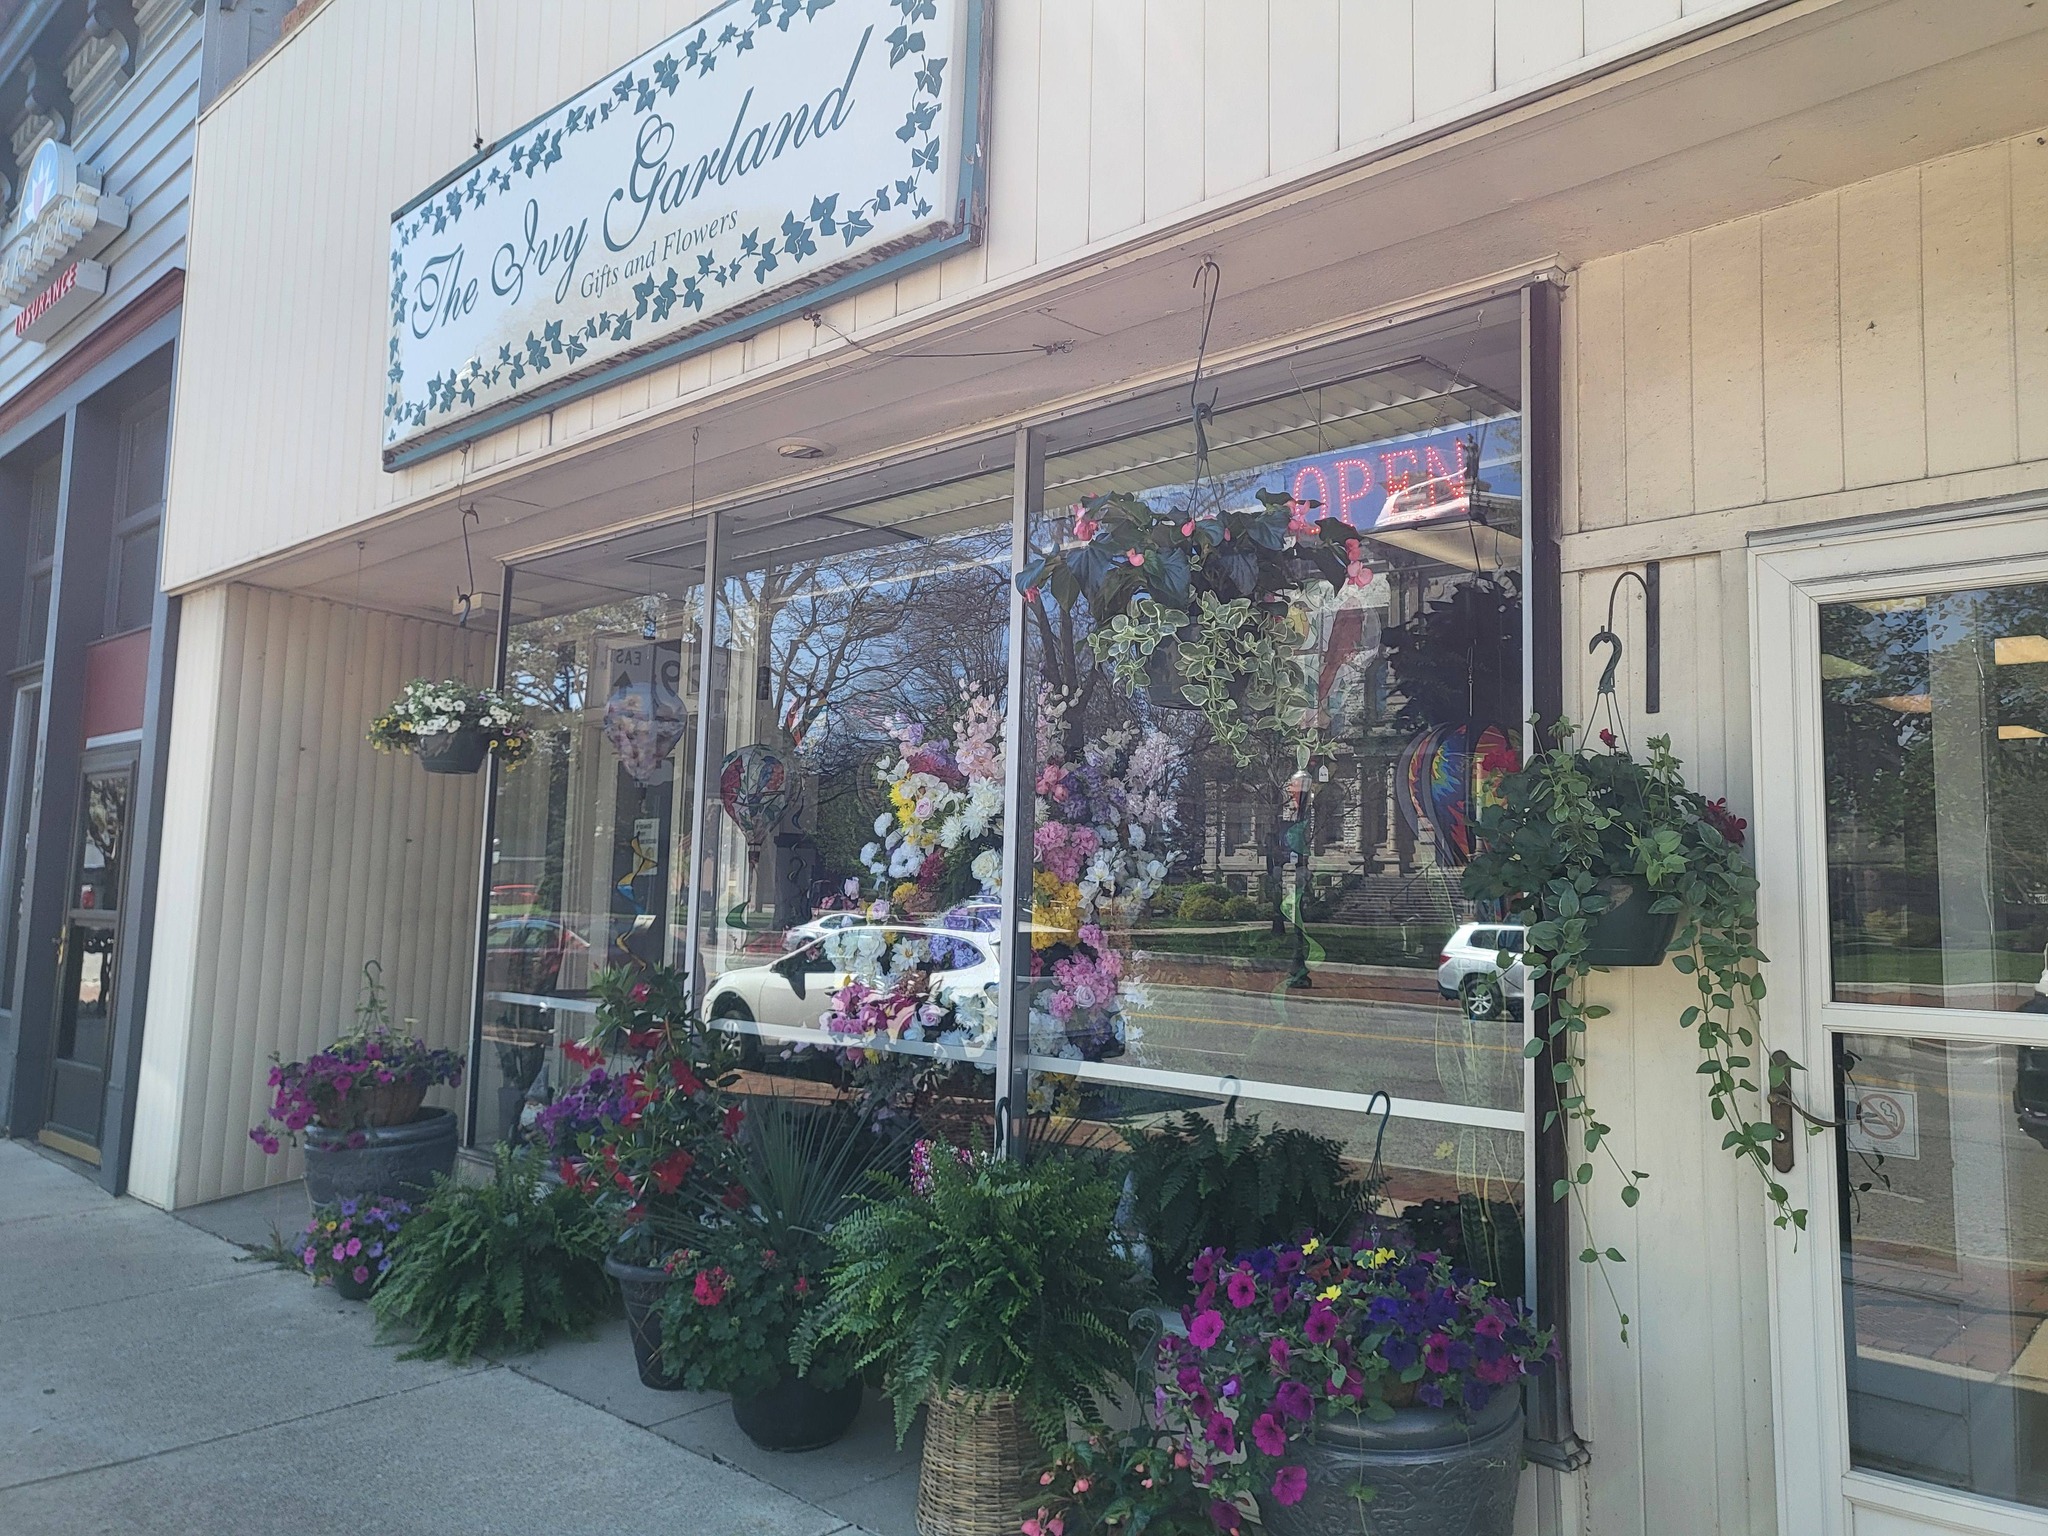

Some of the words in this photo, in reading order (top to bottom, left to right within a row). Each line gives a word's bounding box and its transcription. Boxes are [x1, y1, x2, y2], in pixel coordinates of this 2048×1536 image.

[412, 243, 478, 339] The
[491, 198, 588, 305] Ivy
[603, 24, 874, 251] Garland
[15, 262, 78, 336] INSURANCE
[581, 267, 618, 299] Gifts
[624, 242, 657, 279] and
[662, 210, 738, 261] Flowers
[1293, 438, 1466, 534] OPEN
